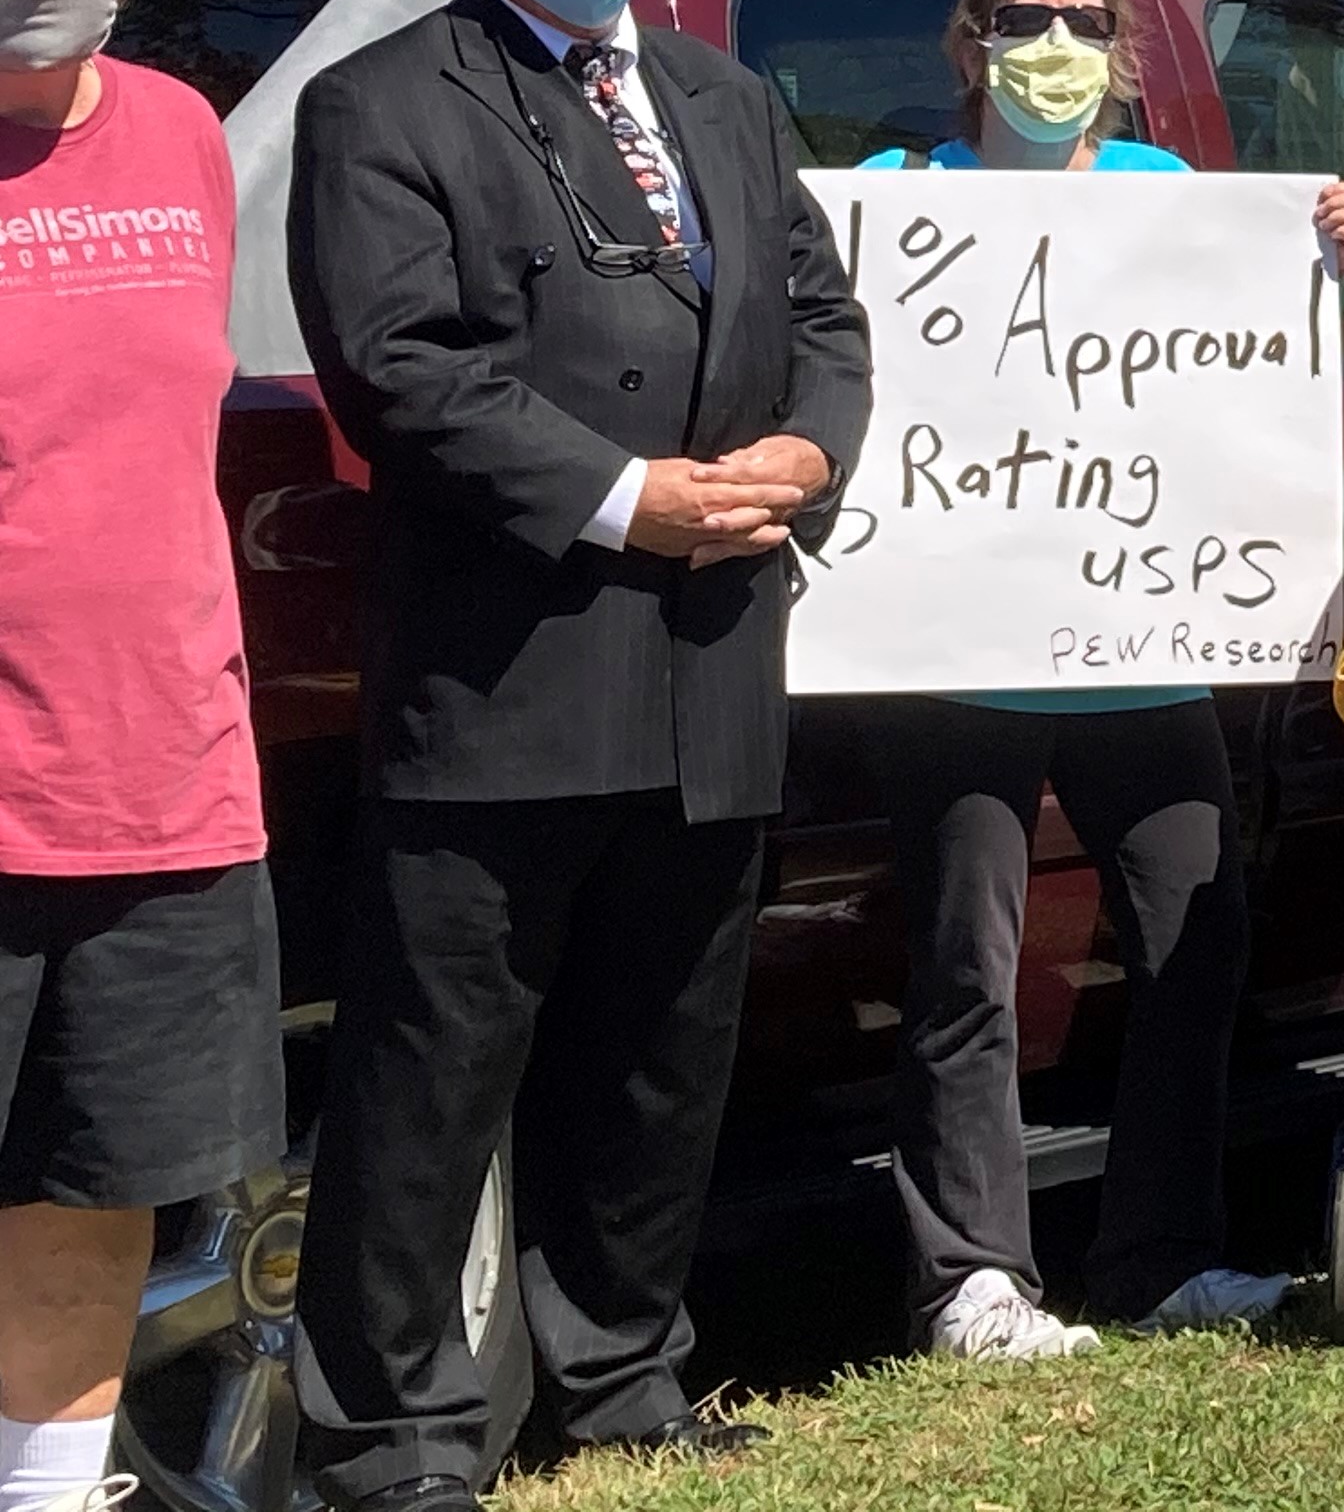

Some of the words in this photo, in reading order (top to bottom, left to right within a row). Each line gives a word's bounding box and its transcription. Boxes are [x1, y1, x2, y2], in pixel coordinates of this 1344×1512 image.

[0, 235, 211, 272] OMPANIE
[994, 233, 1326, 412] Approval
[900, 423, 1162, 528] Rating
